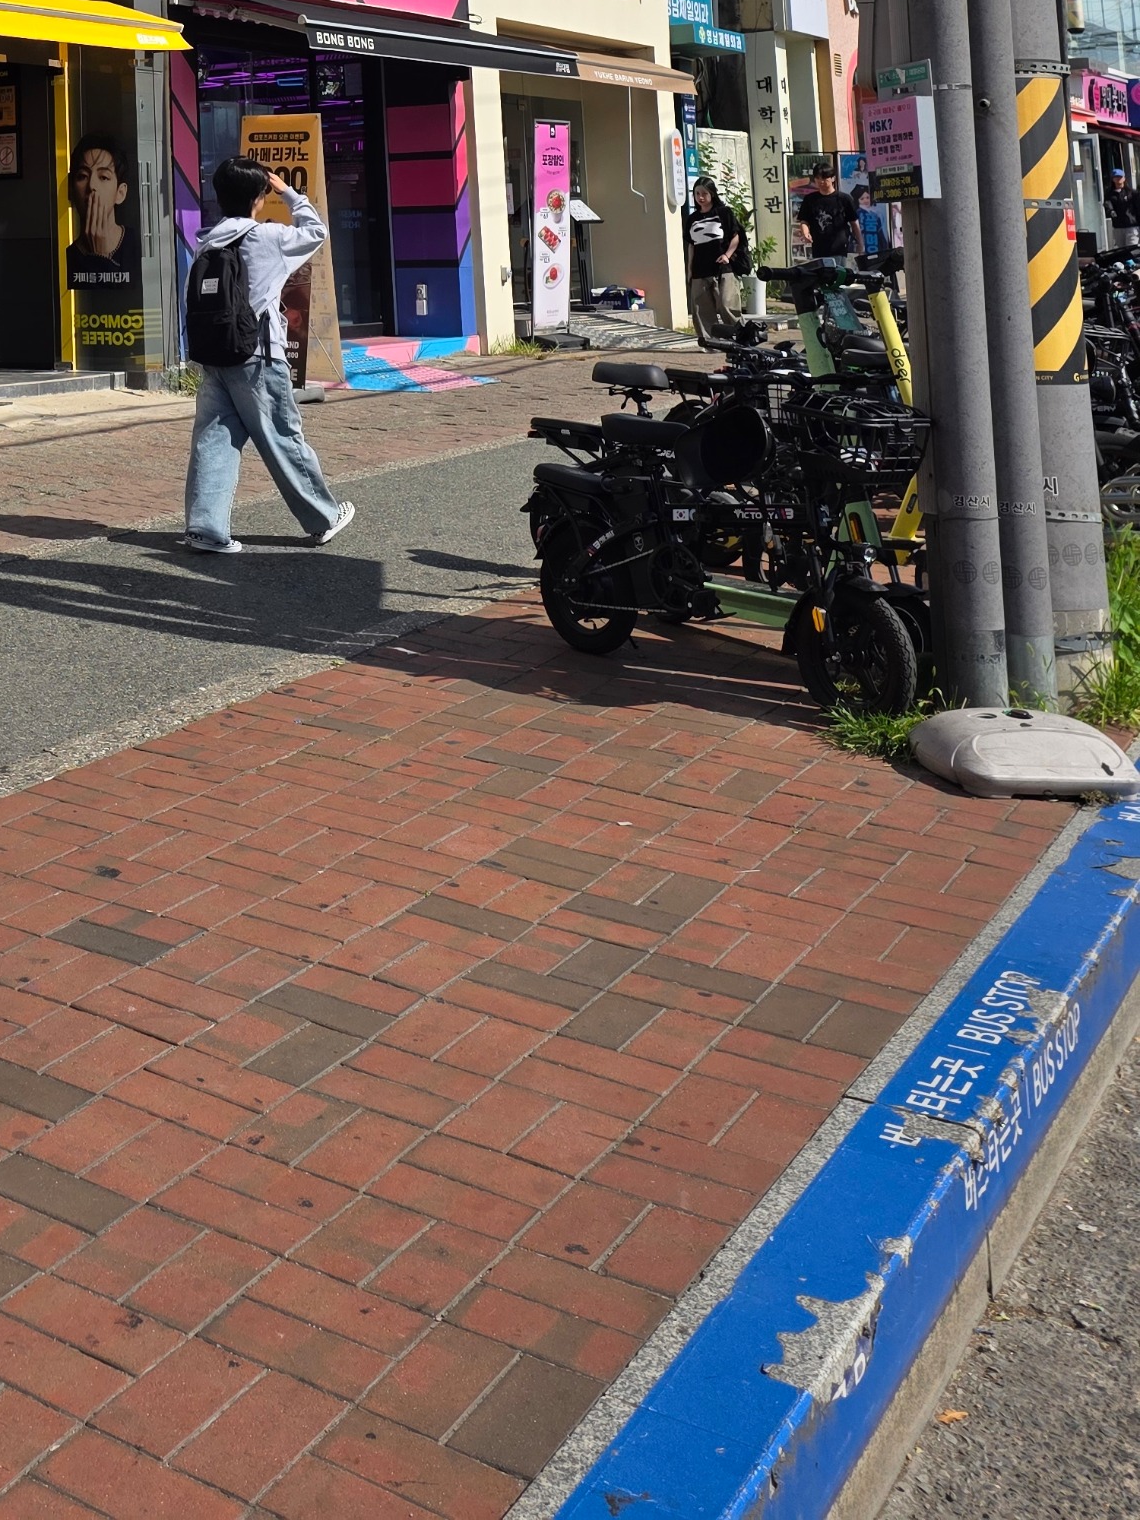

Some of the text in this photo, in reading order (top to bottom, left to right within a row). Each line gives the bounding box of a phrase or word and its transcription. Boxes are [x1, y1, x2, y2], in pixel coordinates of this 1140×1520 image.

[316, 30, 375, 51] BONG BONG
[869, 118, 893, 133] HSK?
[247, 146, 309, 163] 아메리카노
[756, 75, 783, 214] 대학사진관
[890, 347, 911, 383] deer
[733, 508, 779, 520] VICTOY
[1031, 1041, 1057, 1108] BUS
[1054, 1002, 1081, 1072] STOP
